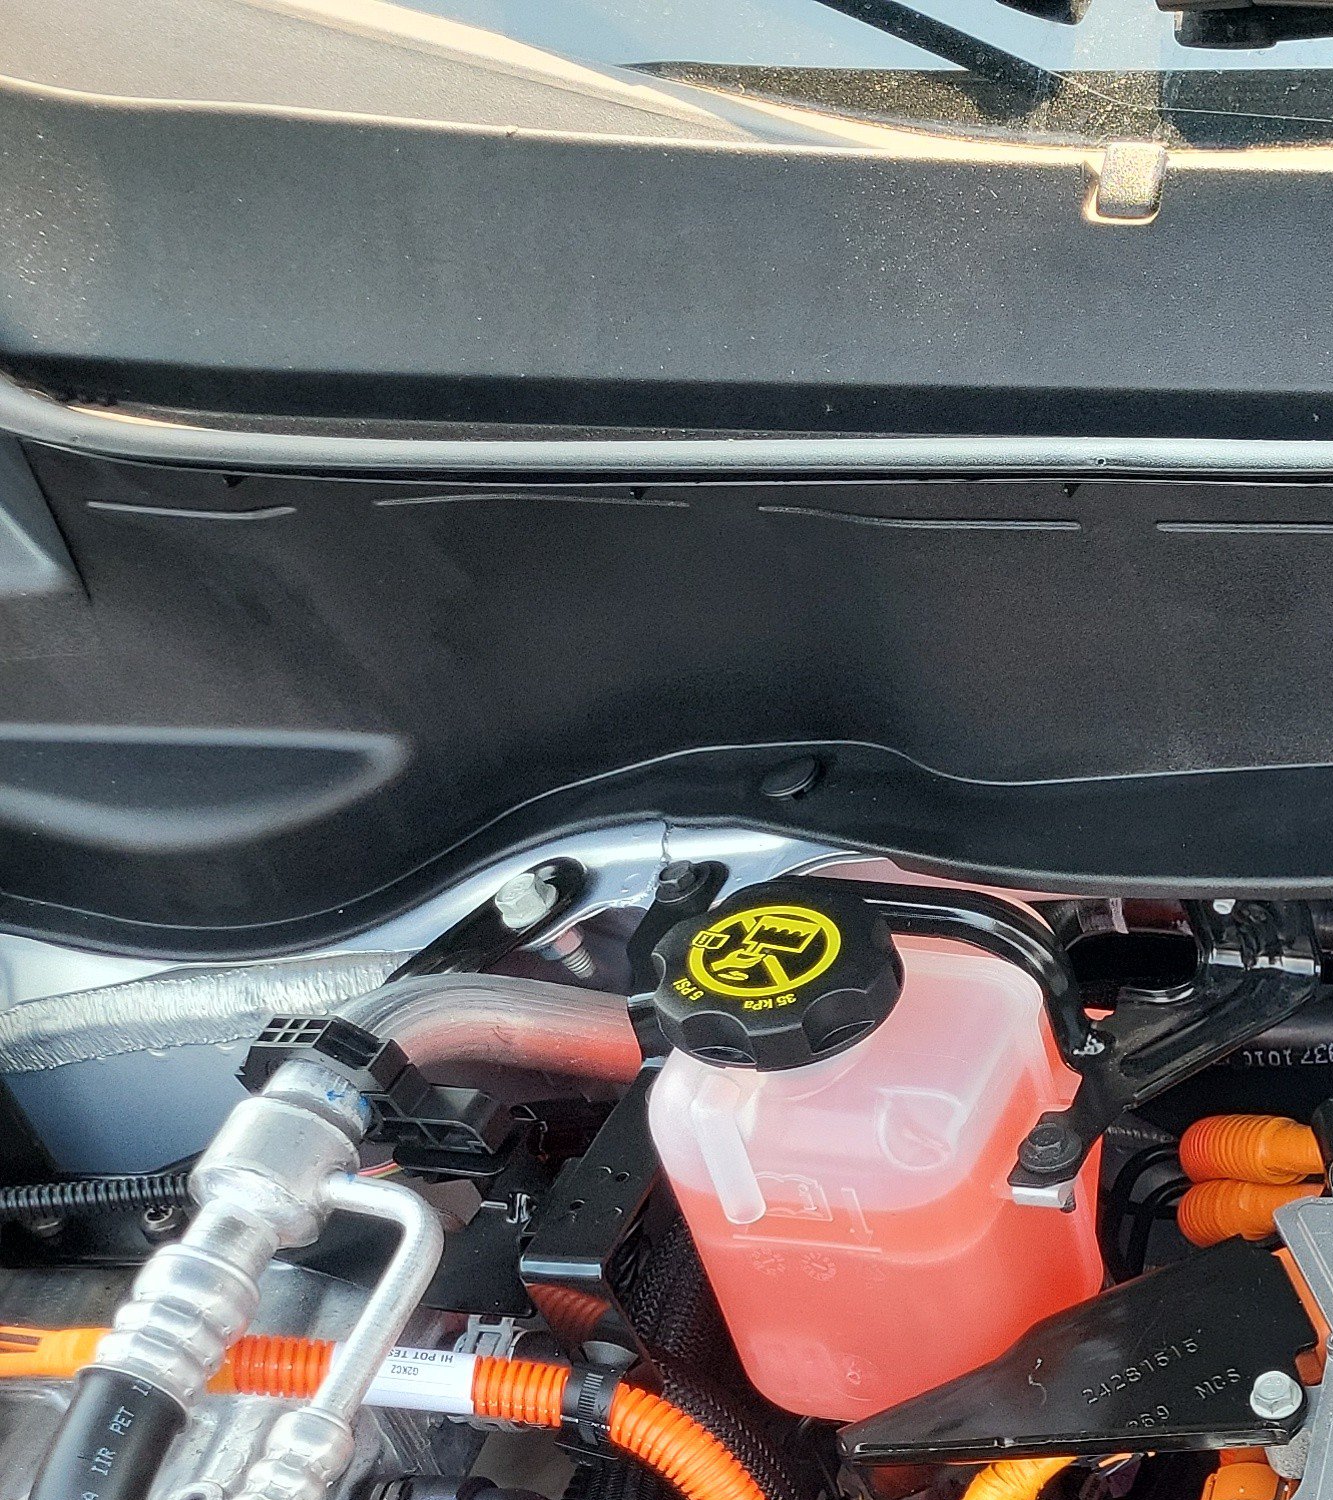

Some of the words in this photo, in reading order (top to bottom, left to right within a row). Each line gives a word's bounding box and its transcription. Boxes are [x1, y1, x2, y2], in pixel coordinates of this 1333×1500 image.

[672, 977, 693, 998] PSI
[743, 998, 774, 1011] kPa
[777, 992, 797, 1008] 35
[415, 1352, 437, 1362] POT
[441, 1354, 455, 1364] HI
[1193, 1368, 1240, 1399] MCS
[110, 1405, 138, 1440] PET
